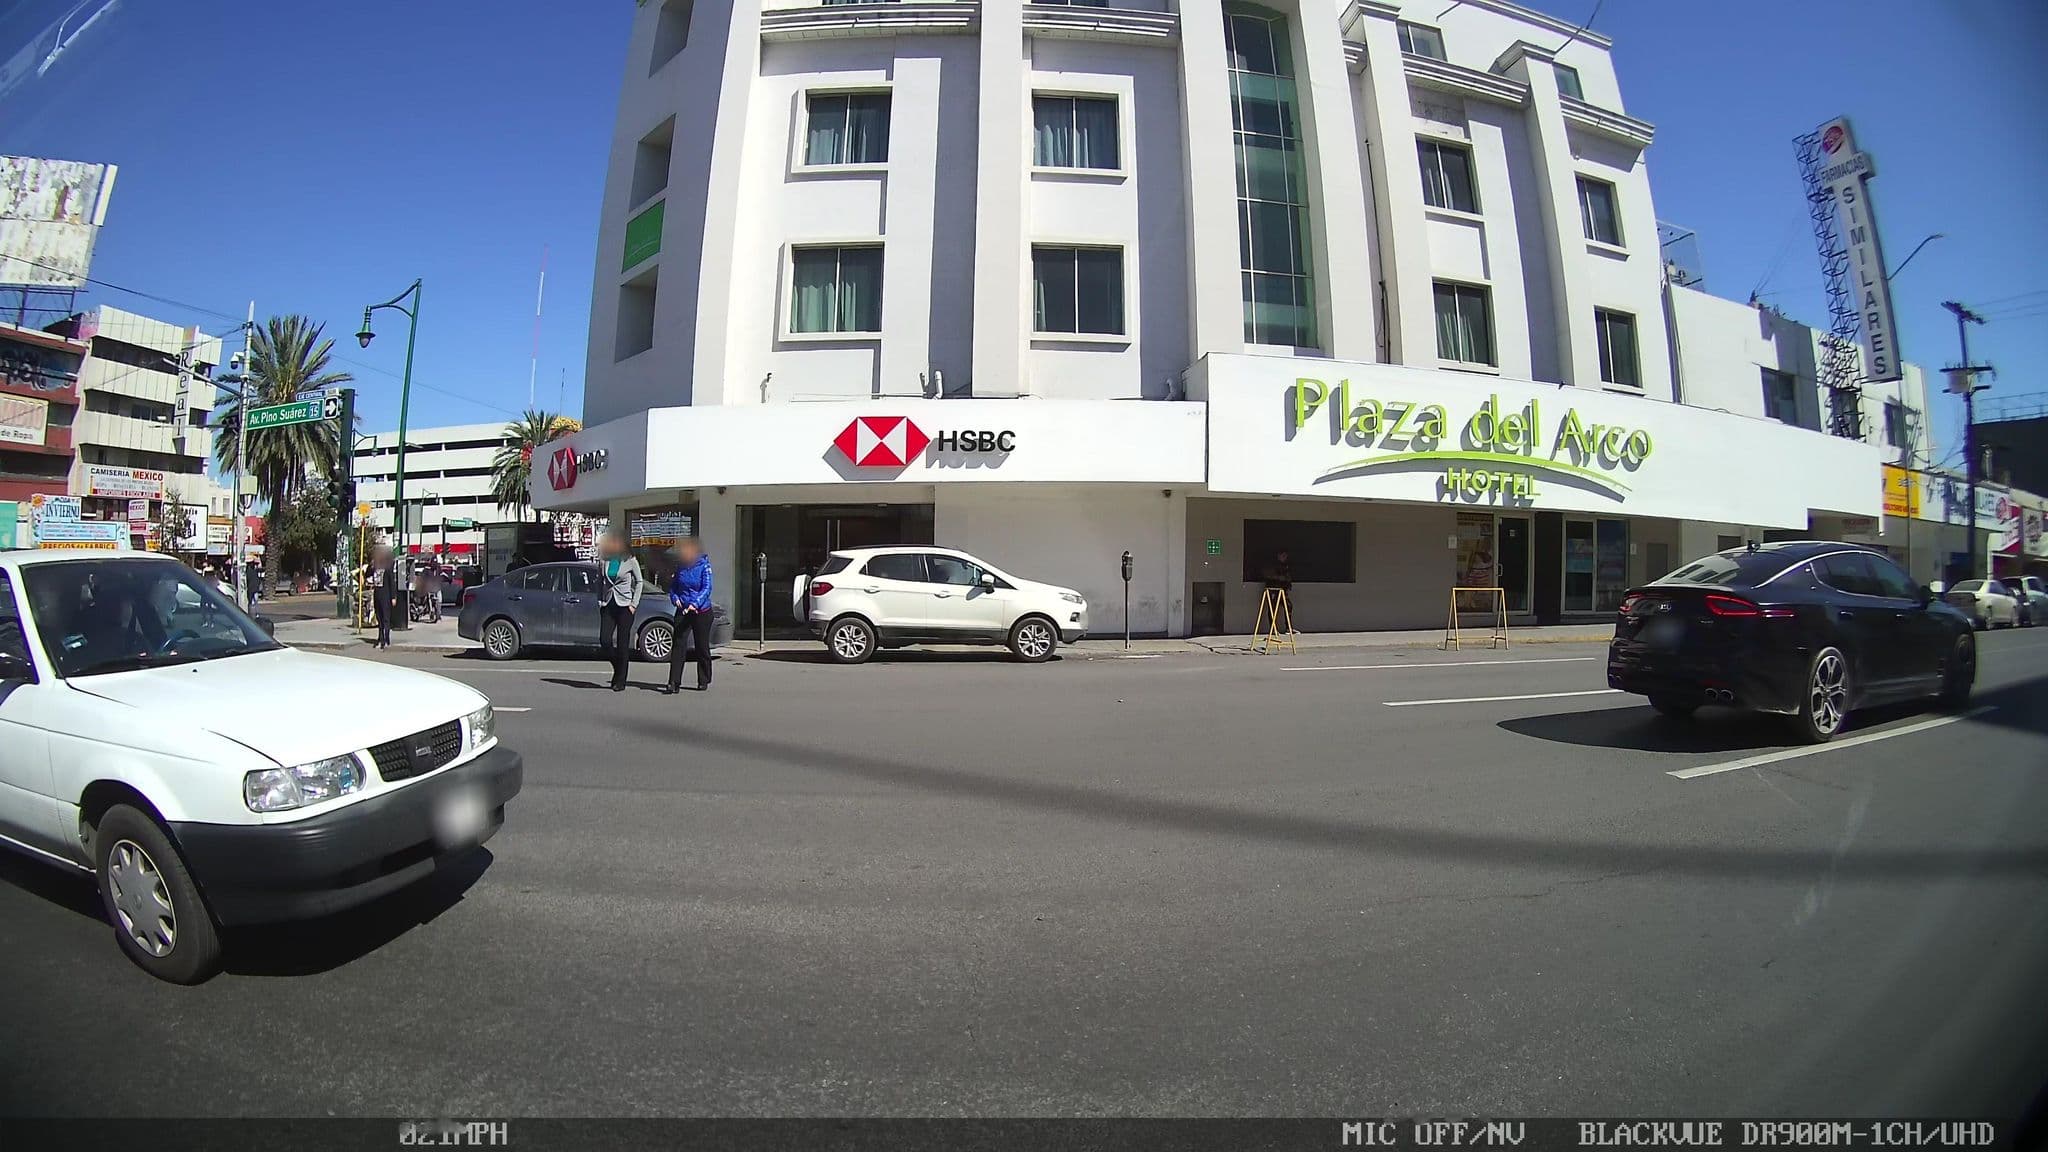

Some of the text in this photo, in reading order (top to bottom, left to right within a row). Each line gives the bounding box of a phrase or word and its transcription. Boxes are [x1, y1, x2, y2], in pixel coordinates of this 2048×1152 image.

[1821, 155, 1865, 183] FARMACIAS
[1842, 186, 1886, 375] SIMILARES
[177, 351, 193, 436] Real
[249, 407, 306, 425] Av. Pino Suárez
[310, 407, 319, 417] 15
[1295, 377, 1652, 460] Plaza del Arco
[938, 430, 1016, 452] HSBC
[577, 449, 605, 473] HSBC
[90, 467, 164, 481] CAMISERIA MEXICO
[1447, 467, 1542, 496] HOTEL
[45, 503, 80, 518] INVIERNO
